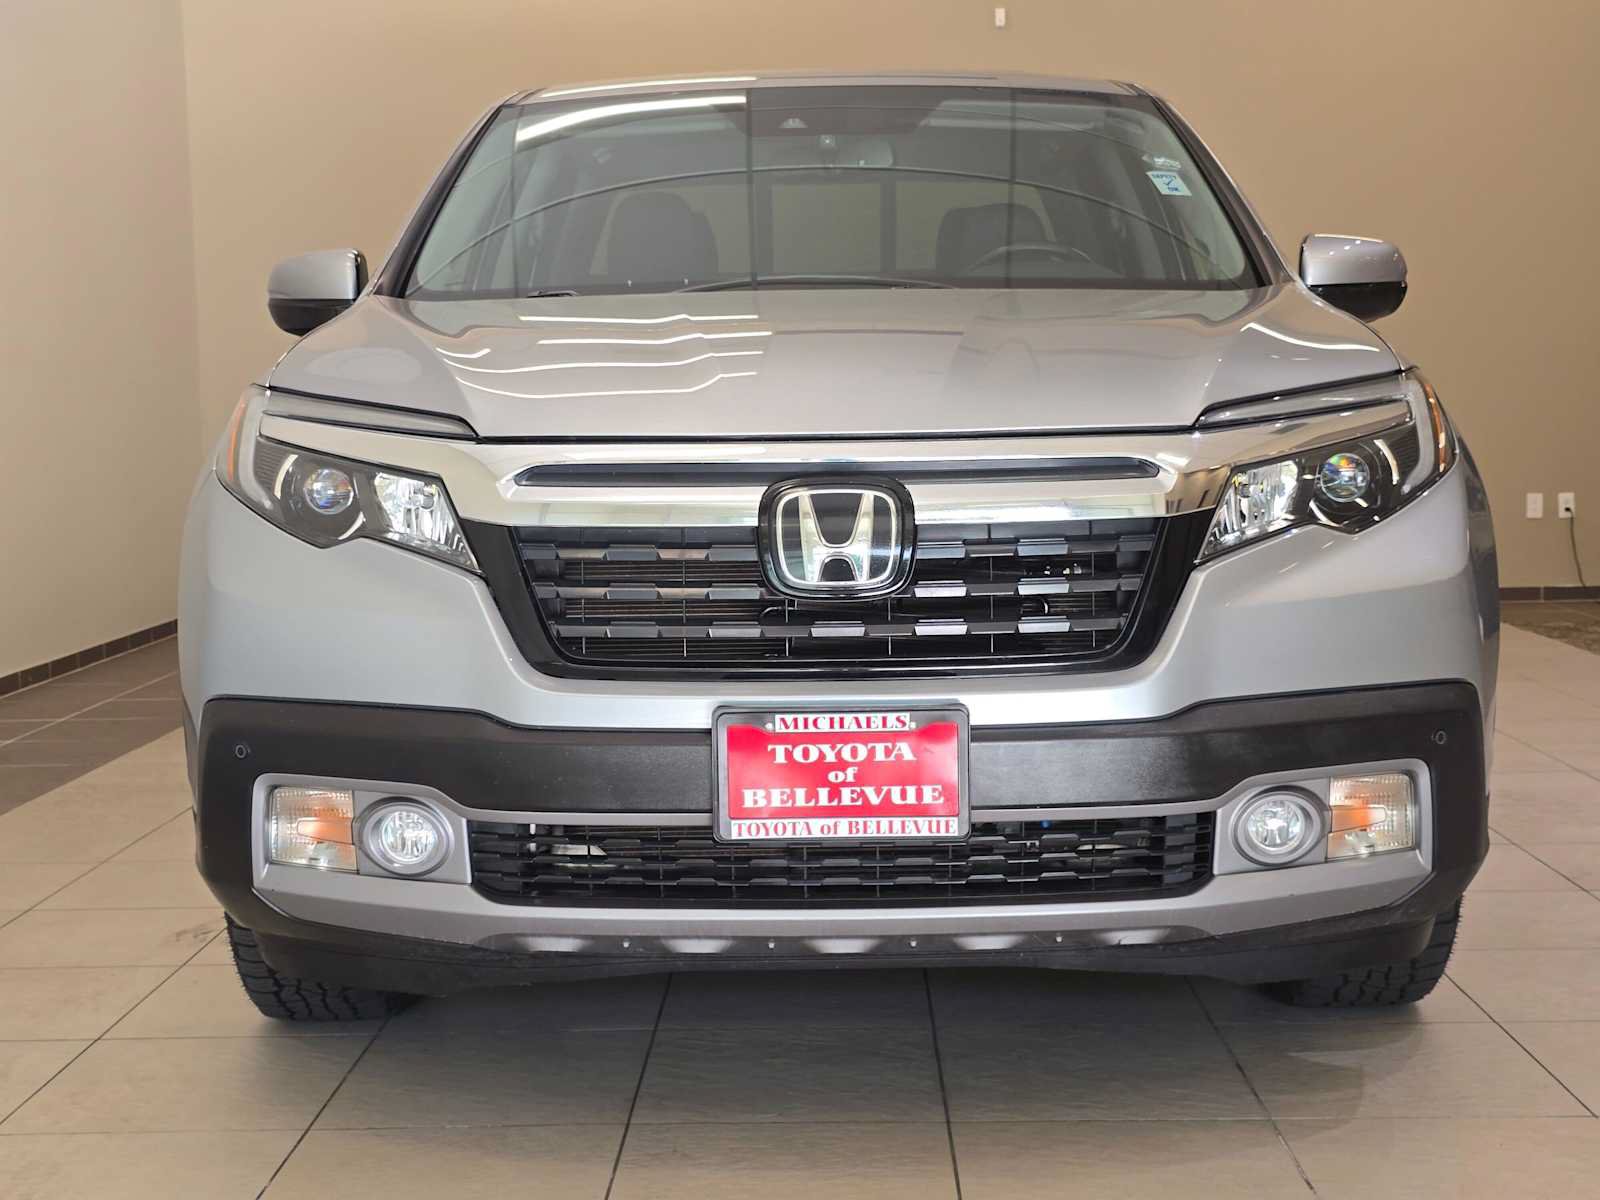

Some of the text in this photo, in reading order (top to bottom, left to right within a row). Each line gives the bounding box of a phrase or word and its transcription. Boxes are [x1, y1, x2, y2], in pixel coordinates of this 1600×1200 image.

[778, 715, 908, 730] MICHAELS
[768, 742, 917, 763] TOYOTA
[827, 767, 858, 783] of
[742, 784, 945, 808] BELLEVUE
[733, 819, 956, 837] TOYOTA of BELLEVUE
